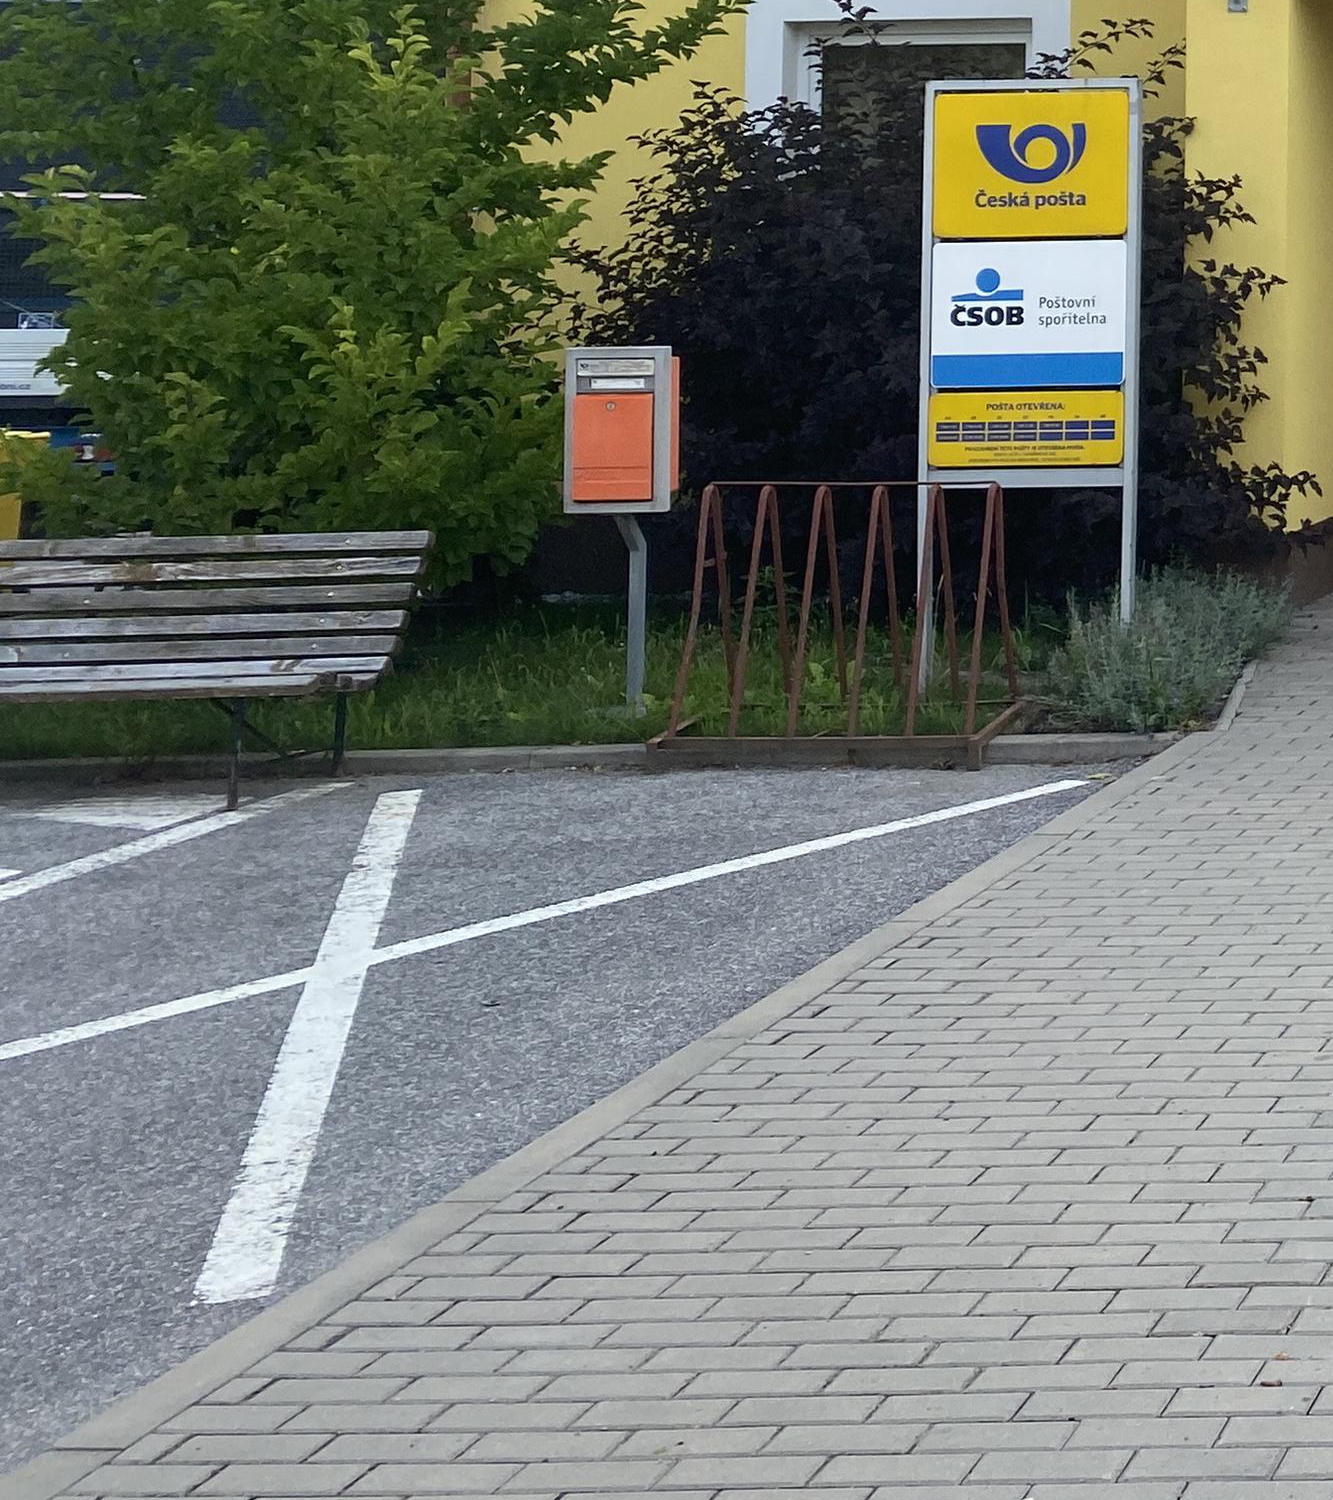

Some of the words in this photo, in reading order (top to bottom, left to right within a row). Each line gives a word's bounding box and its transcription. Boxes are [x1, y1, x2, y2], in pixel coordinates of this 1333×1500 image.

[975, 189, 1030, 208] Česká
[1034, 191, 1087, 210] pošta
[1038, 295, 1097, 309] Poštovní
[950, 303, 1025, 327] ČSOB
[1038, 312, 1107, 329] spořitelna
